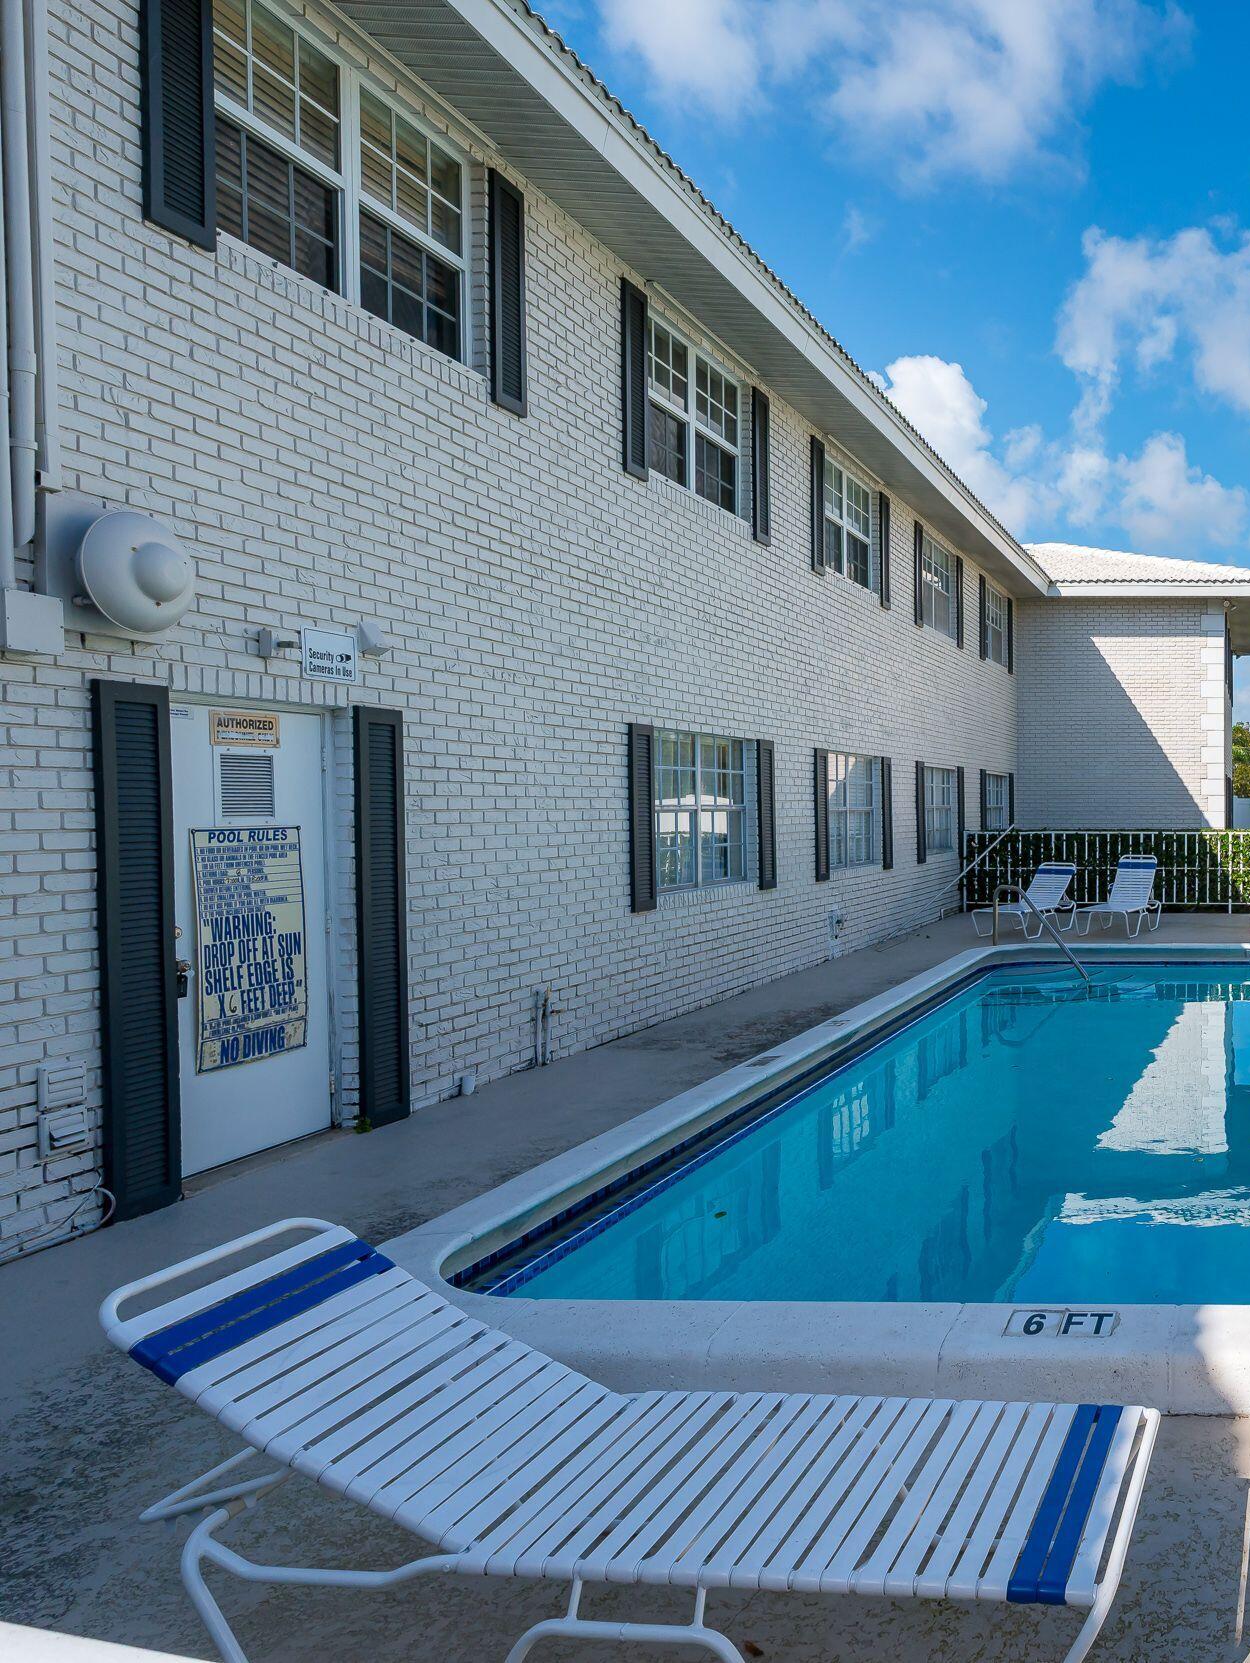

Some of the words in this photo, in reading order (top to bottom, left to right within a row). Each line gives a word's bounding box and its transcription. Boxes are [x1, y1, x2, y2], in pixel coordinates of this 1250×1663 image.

[308, 648, 334, 662] Security
[308, 661, 334, 675] Cameras
[335, 666, 341, 676] In
[342, 666, 352, 678] Use
[217, 718, 274, 730] AUTHORIZED
[208, 832, 244, 843] POOL
[248, 830, 288, 842] RULES
[204, 941, 235, 970] DROP
[238, 938, 258, 964] OFF
[262, 935, 275, 960] AT
[278, 932, 301, 957] SUN
[205, 964, 244, 996] SHELF
[247, 959, 279, 987] EDGE
[282, 957, 294, 981] IS
[218, 994, 226, 1019] X
[229, 994, 237, 1013] 6
[240, 986, 266, 1014] FEET
[220, 1037, 240, 1064] NO
[243, 1026, 285, 1059] DIVING
[1022, 1313, 1046, 1335] 6
[1062, 1313, 1113, 1335] FT
